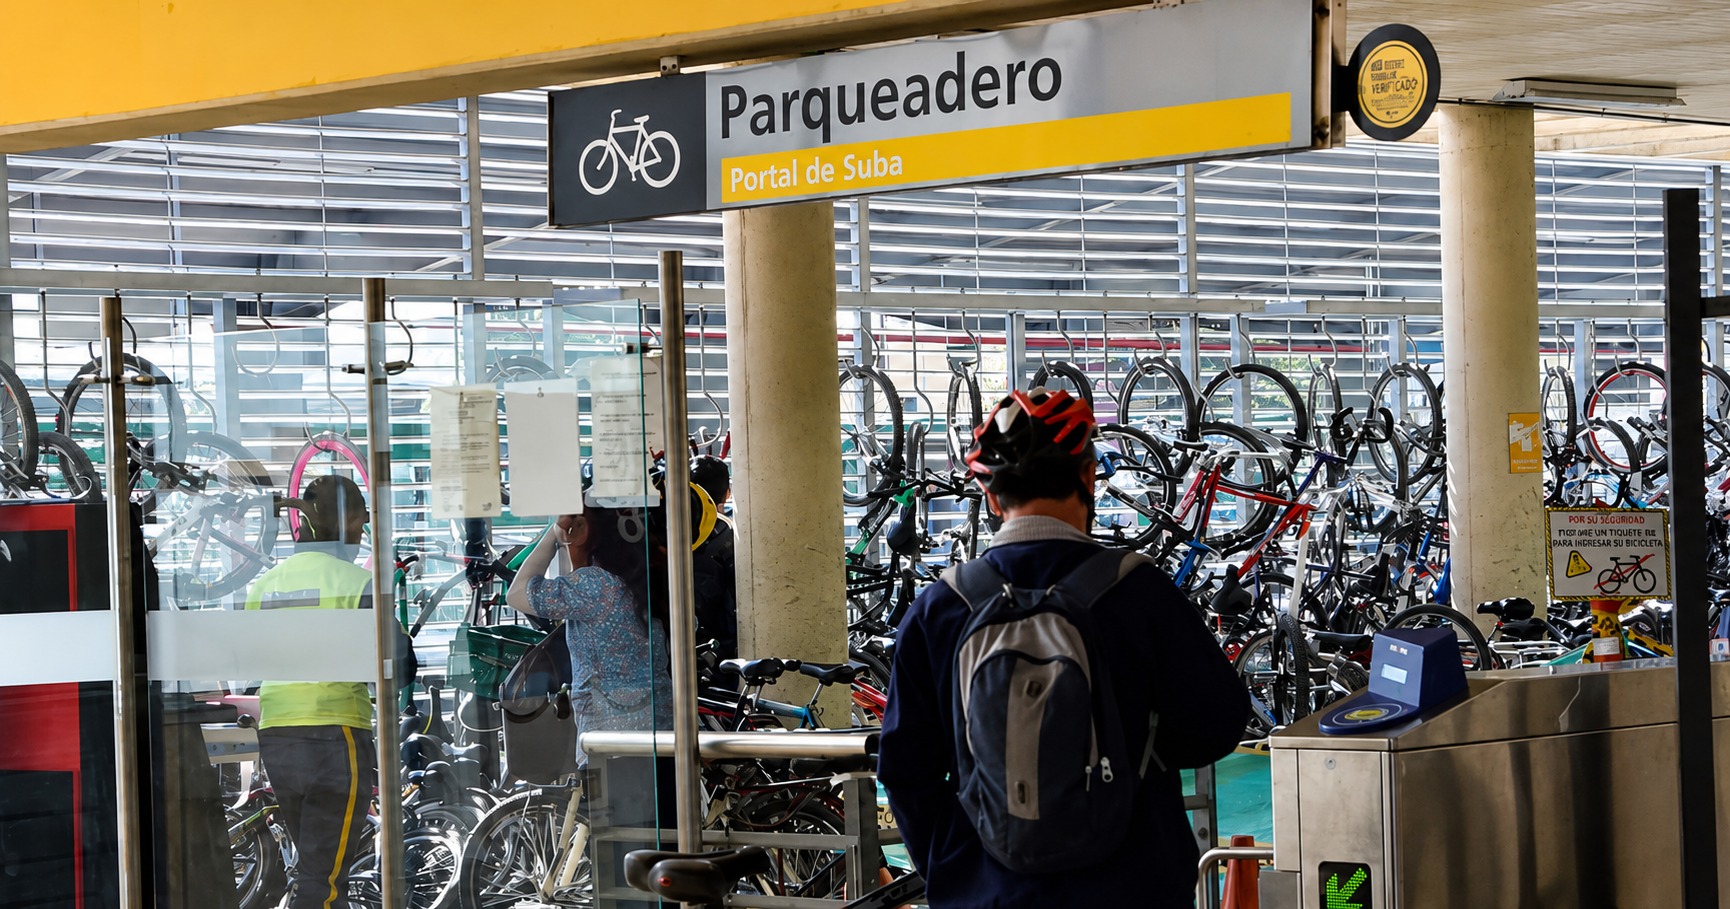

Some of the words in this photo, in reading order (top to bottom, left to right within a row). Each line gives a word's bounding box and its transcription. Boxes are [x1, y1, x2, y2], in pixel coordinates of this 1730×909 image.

[721, 50, 1062, 144] Parqueadero
[731, 159, 798, 193] Portal
[806, 156, 835, 185] de
[843, 150, 903, 181] Suba
[1568, 515, 1586, 524] POR
[1587, 515, 1598, 524] SU
[1600, 515, 1645, 524] SEGURIDAD
[1594, 529, 1607, 537] UN
[1552, 539, 1573, 548] PARA
[1575, 539, 1612, 548] INGRESAR
[1614, 540, 1624, 548] SU
[1625, 539, 1664, 548] BICICLETA
